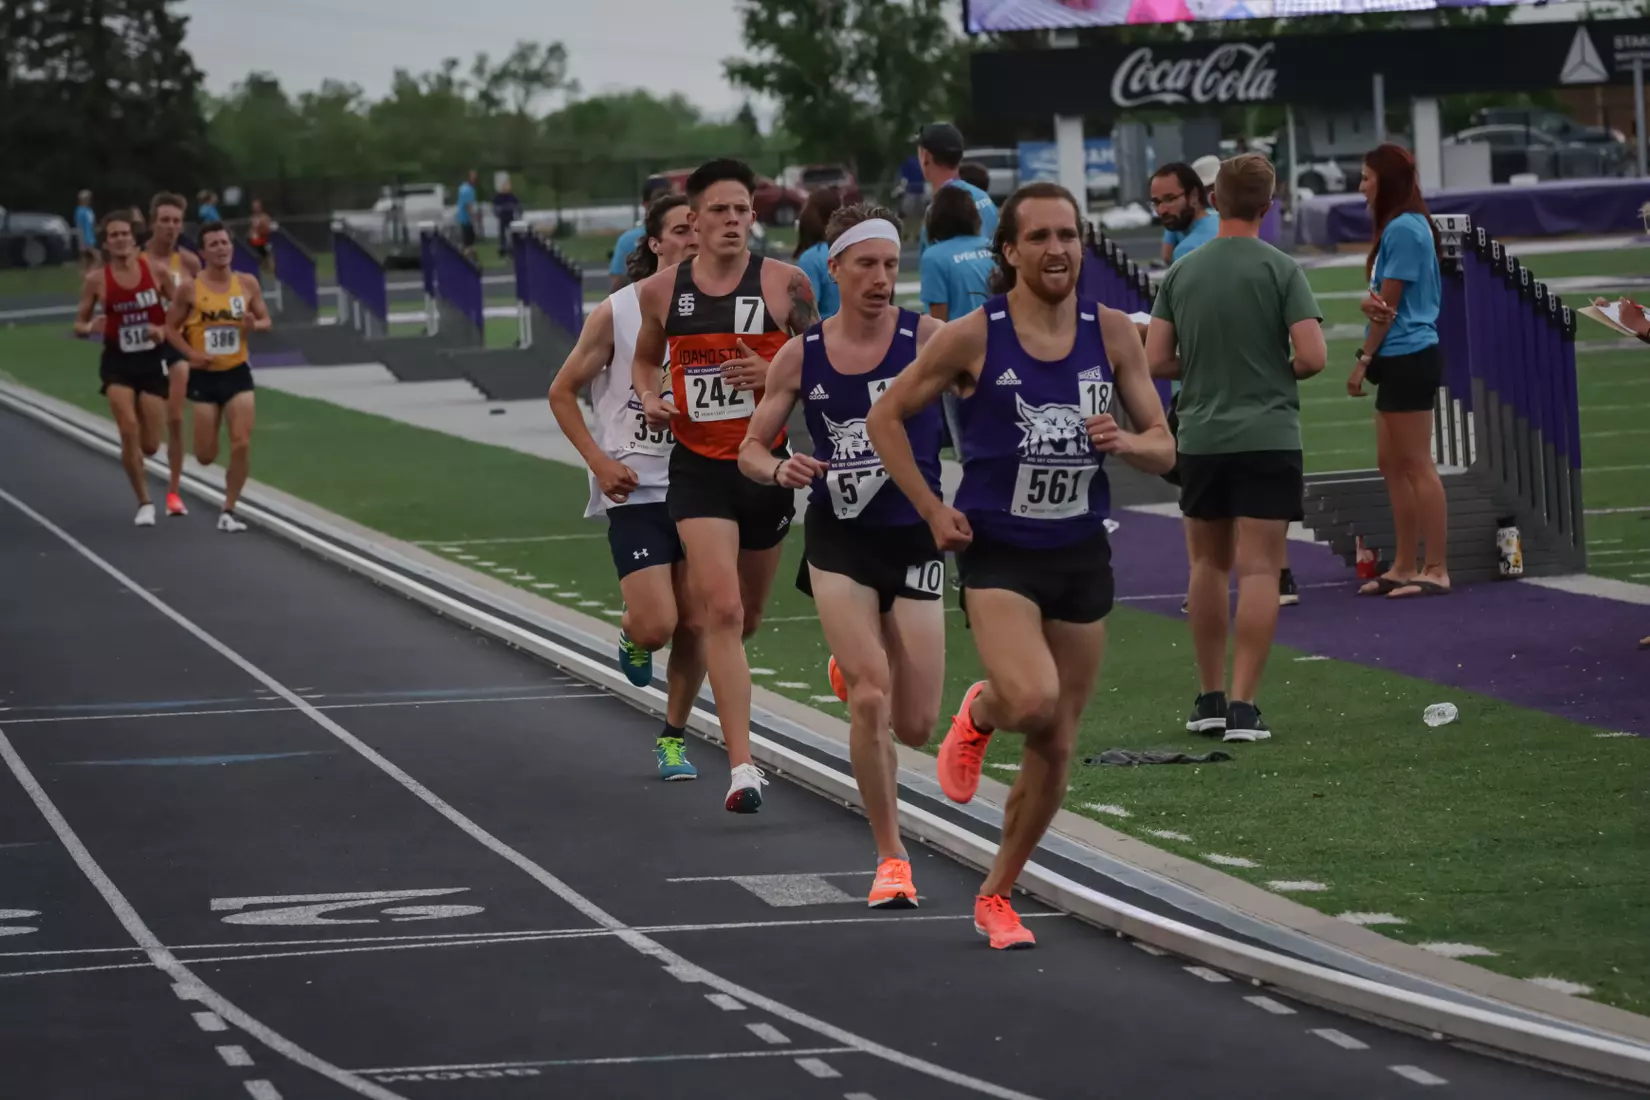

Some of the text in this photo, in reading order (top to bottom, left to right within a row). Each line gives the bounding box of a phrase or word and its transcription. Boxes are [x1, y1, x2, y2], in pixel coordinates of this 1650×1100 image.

[742, 299, 759, 333] 7
[679, 348, 716, 366] IDAHO
[719, 347, 759, 363] STA
[693, 376, 744, 409] 242
[995, 378, 1022, 386] adidas
[1087, 384, 1109, 415] 18
[1027, 469, 1083, 504] 561
[915, 562, 941, 591] 10
